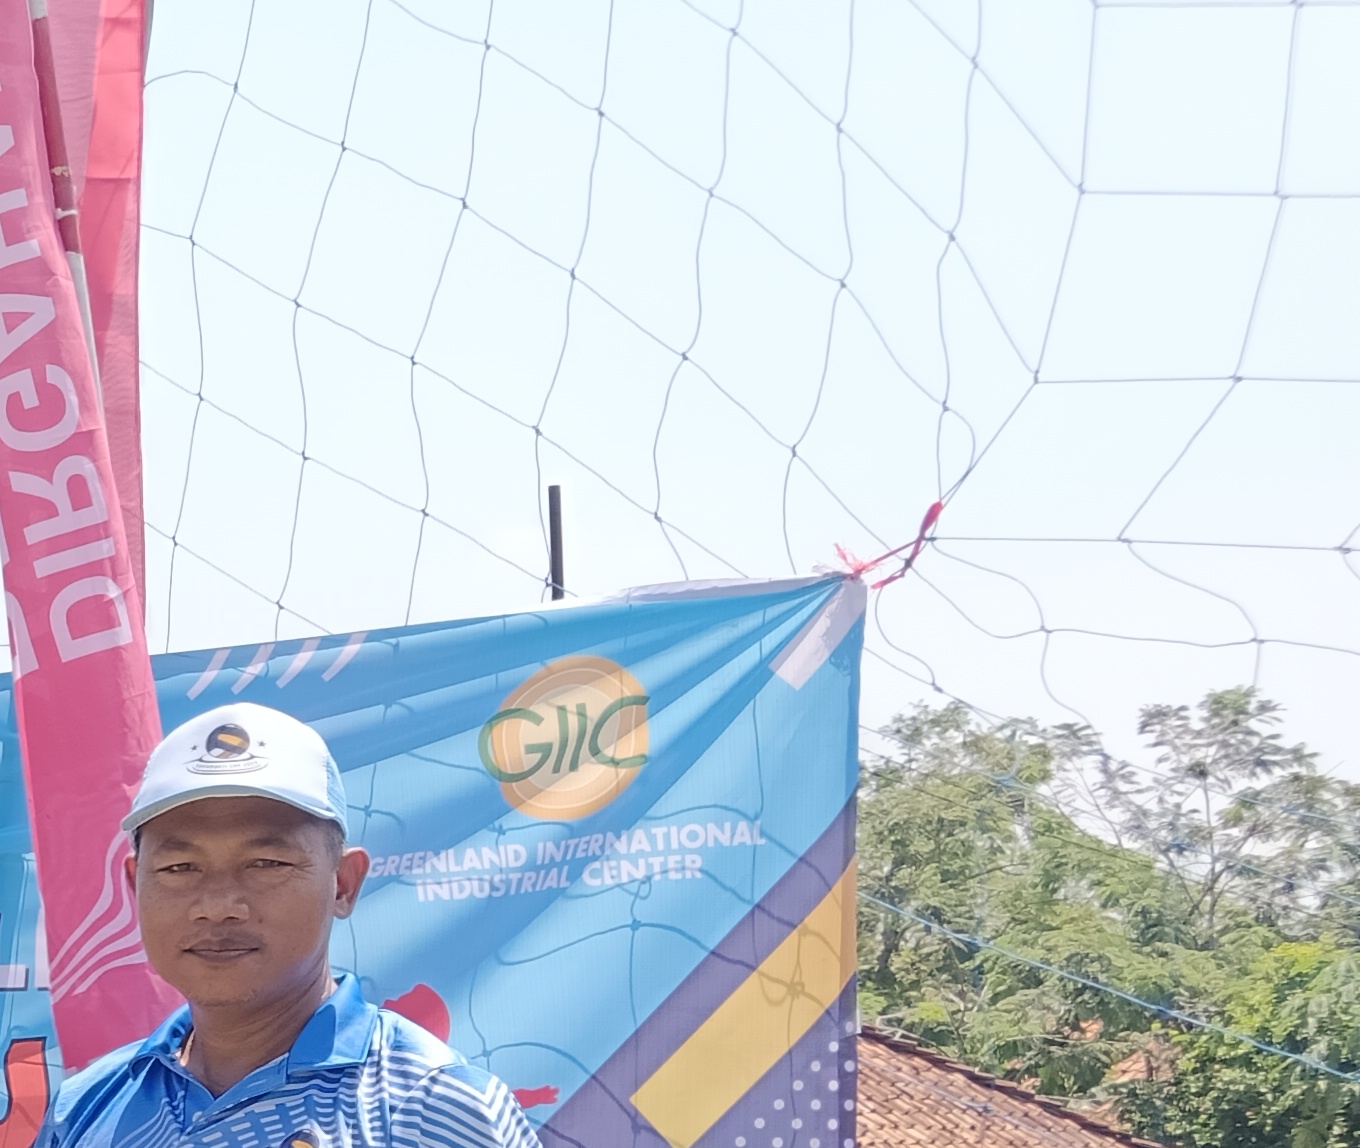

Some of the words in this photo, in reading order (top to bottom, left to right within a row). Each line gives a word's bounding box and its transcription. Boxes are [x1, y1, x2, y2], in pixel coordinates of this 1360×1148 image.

[369, 844, 527, 879] GREENLAND
[536, 820, 767, 866] INTERNATIONAL
[416, 865, 571, 902] INDUSTRIAL
[582, 854, 704, 887] CENTER
